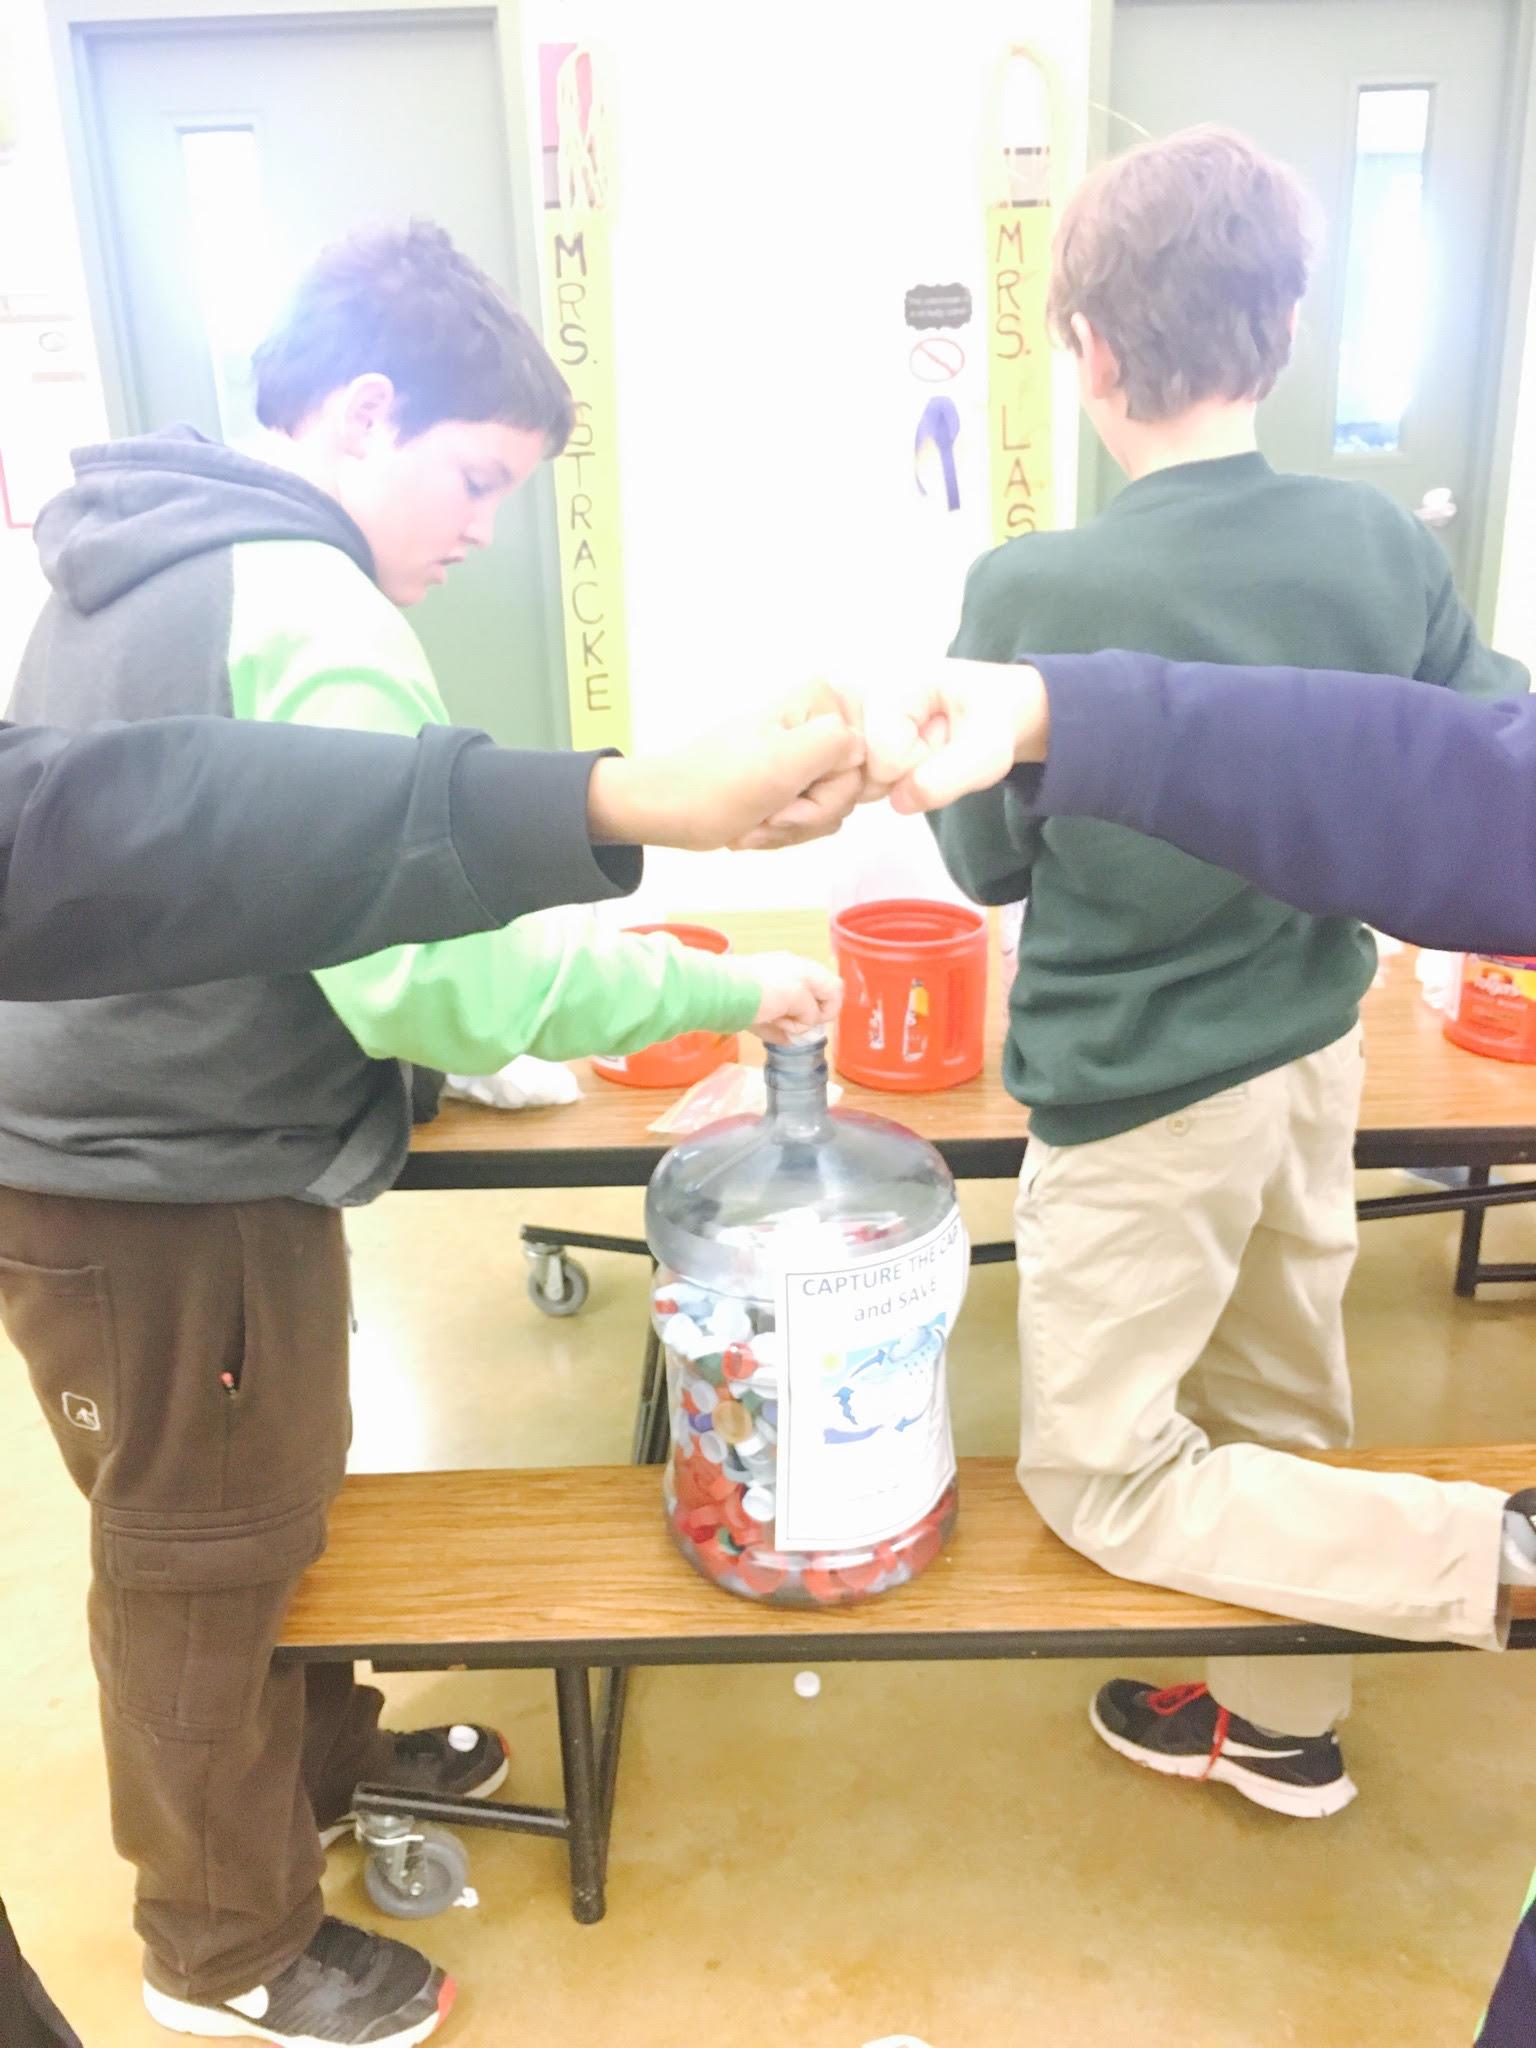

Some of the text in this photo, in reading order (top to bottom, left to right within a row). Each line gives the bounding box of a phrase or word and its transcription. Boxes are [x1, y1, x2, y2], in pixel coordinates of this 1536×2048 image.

[995, 220, 1032, 360] MRS.
[554, 233, 612, 711] MRS. STRACKE
[802, 1264, 901, 1296] CAPTURE
[908, 1245, 936, 1273] THE
[854, 1278, 936, 1321] and SAVE
